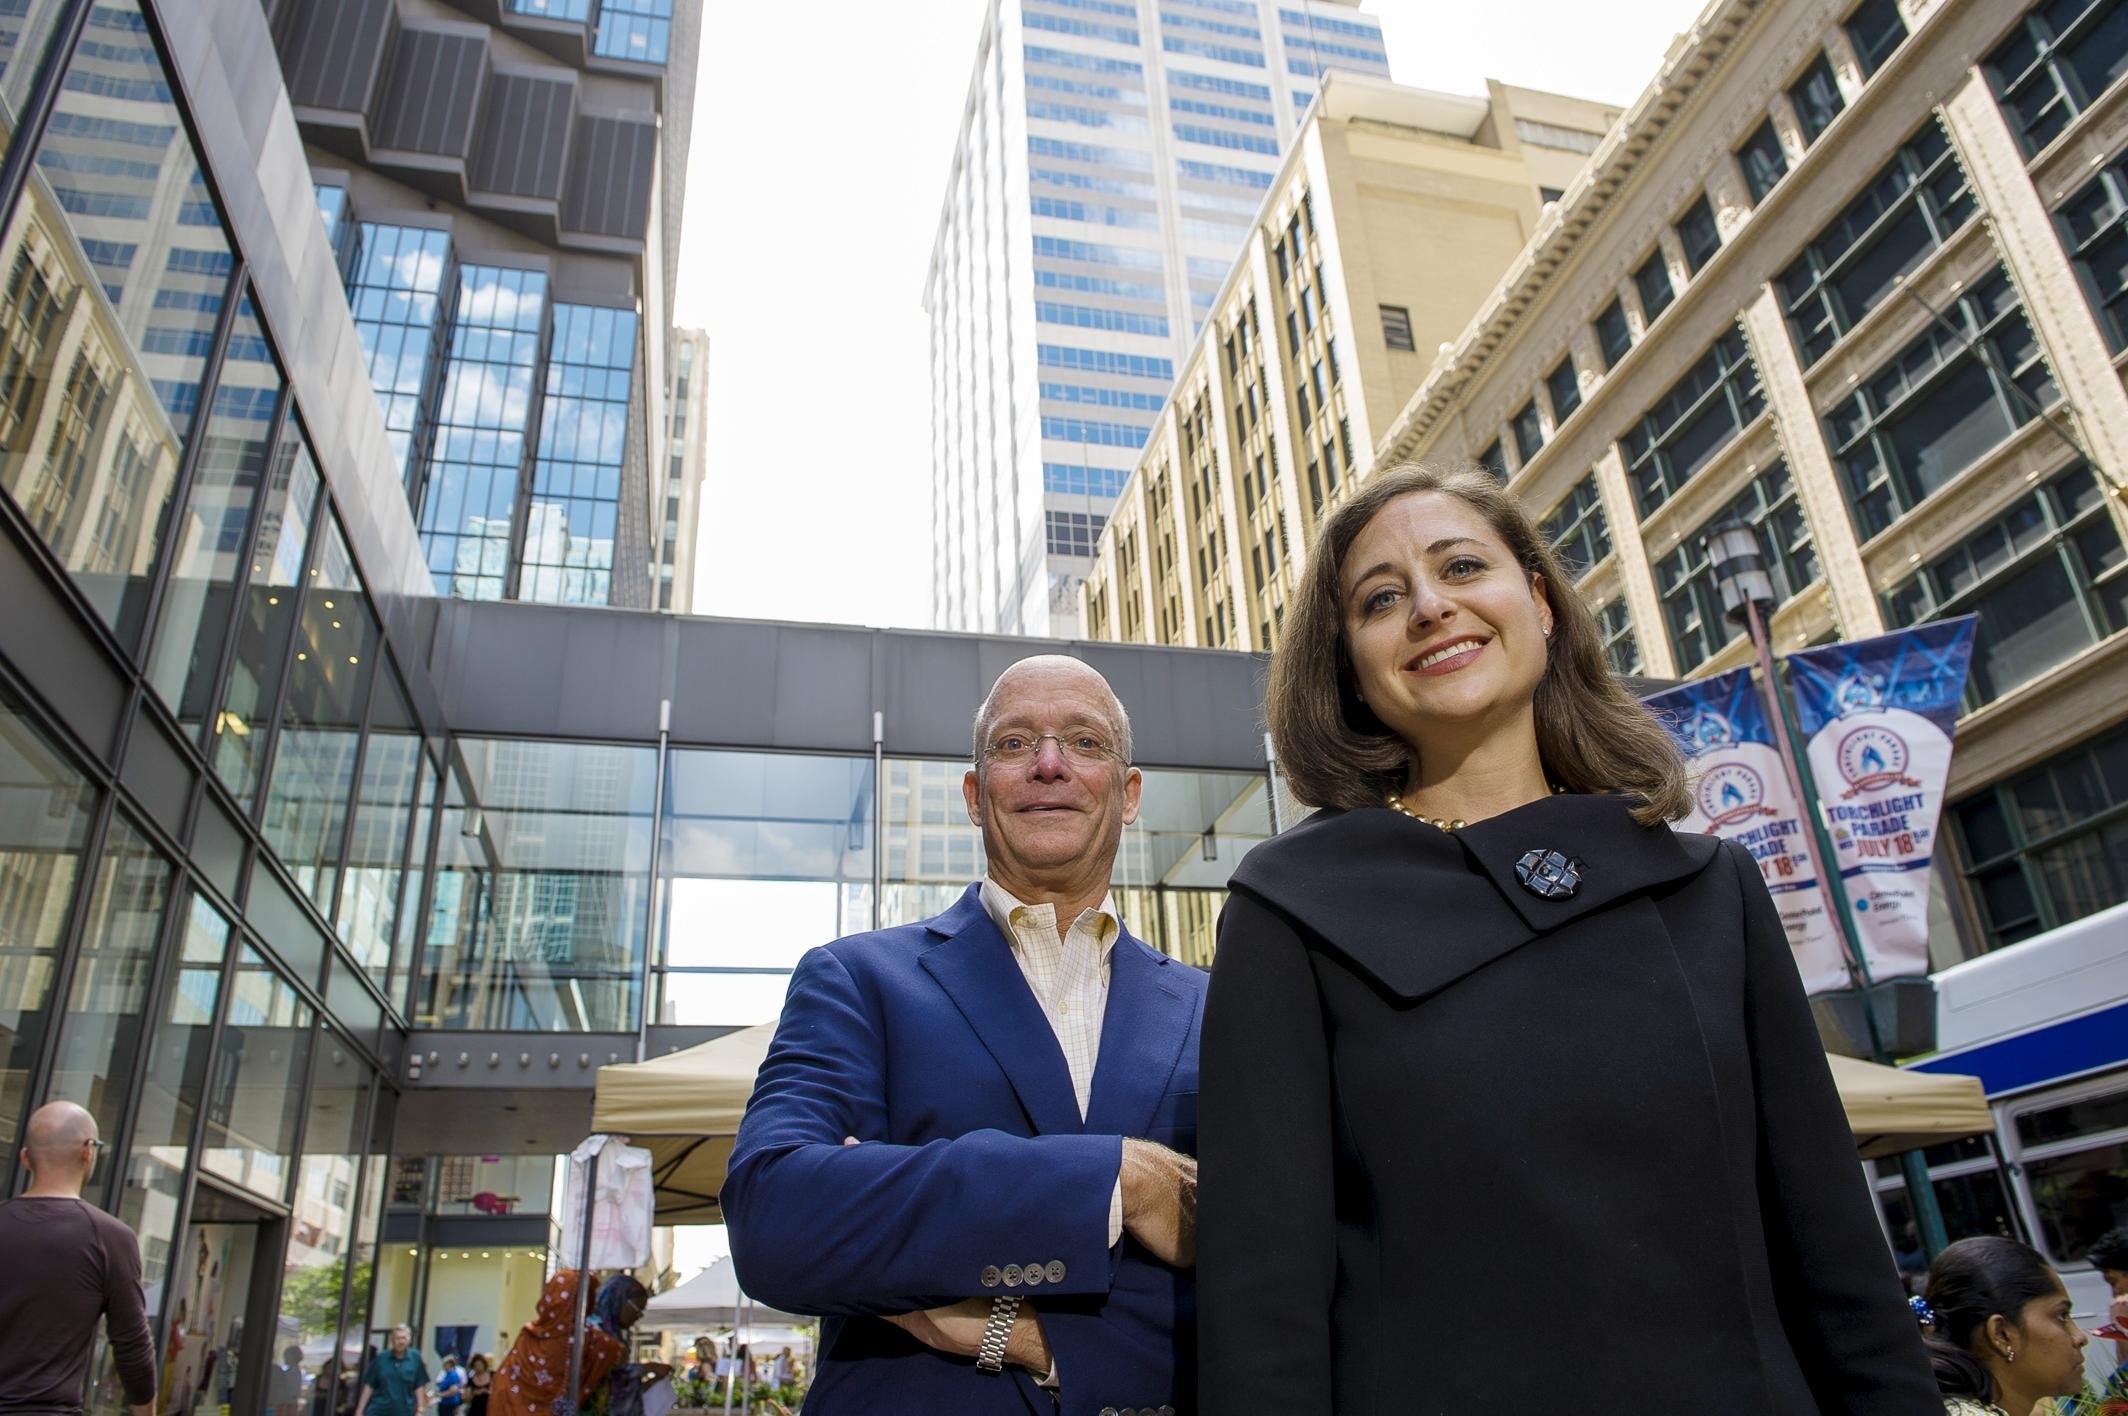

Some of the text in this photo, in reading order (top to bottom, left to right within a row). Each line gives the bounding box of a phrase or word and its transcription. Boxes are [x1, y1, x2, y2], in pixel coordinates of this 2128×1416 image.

[1827, 793, 1924, 823] TORCHLIGHT
[1728, 819, 1799, 846] CHLIGHT
[1851, 815, 1910, 836] PARADE
[1857, 838, 1890, 857] JULY
[1894, 832, 1914, 855] 18
[1773, 856, 1793, 877] 18
